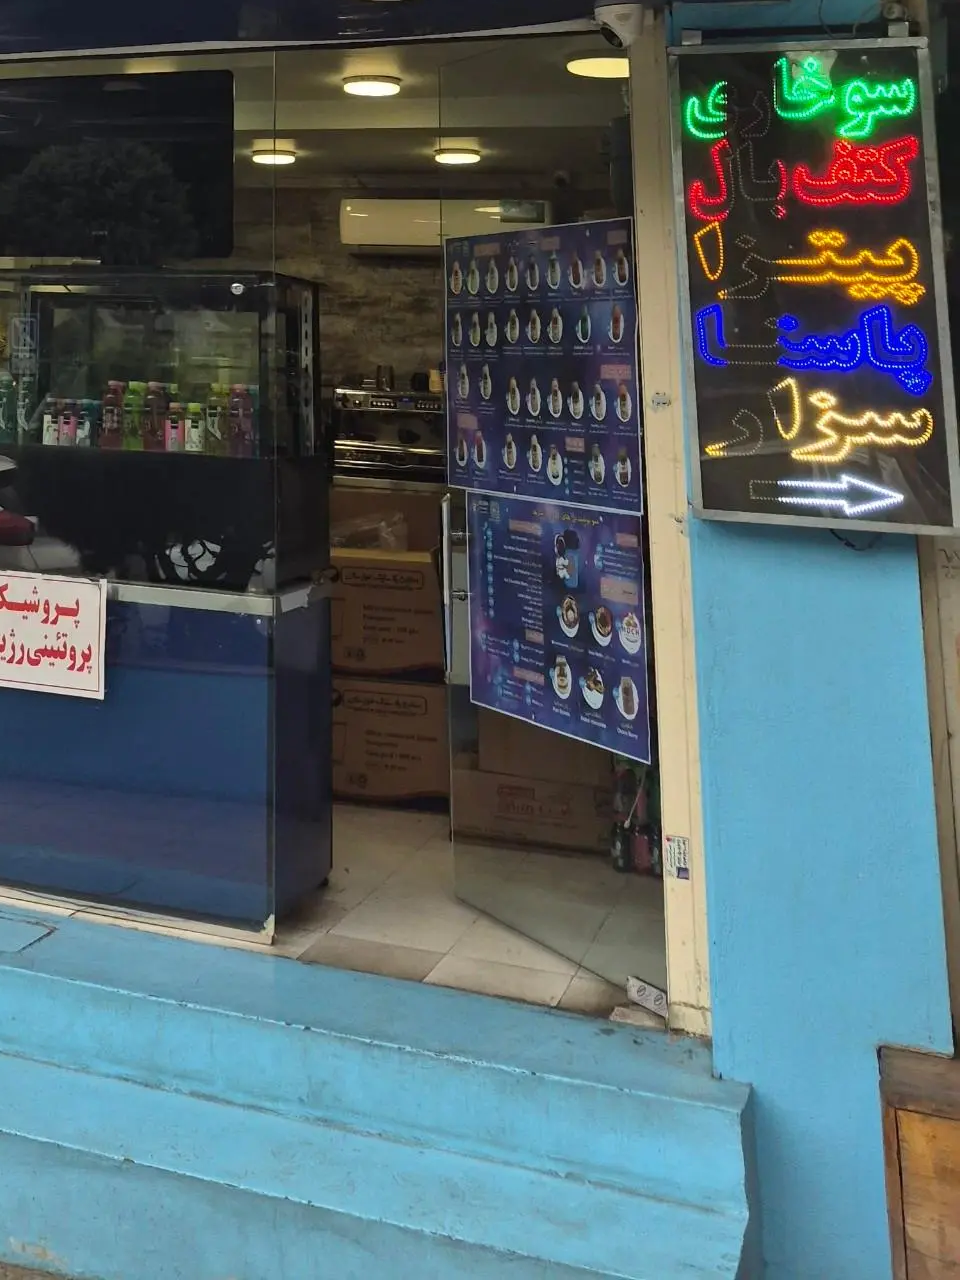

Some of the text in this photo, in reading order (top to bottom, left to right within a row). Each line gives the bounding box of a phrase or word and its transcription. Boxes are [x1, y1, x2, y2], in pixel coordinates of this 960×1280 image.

[792, 134, 919, 206] کتف
[693, 220, 926, 306] پیتزا
[695, 303, 934, 396] پاستا
[26, 630, 93, 675] پروتئینی
